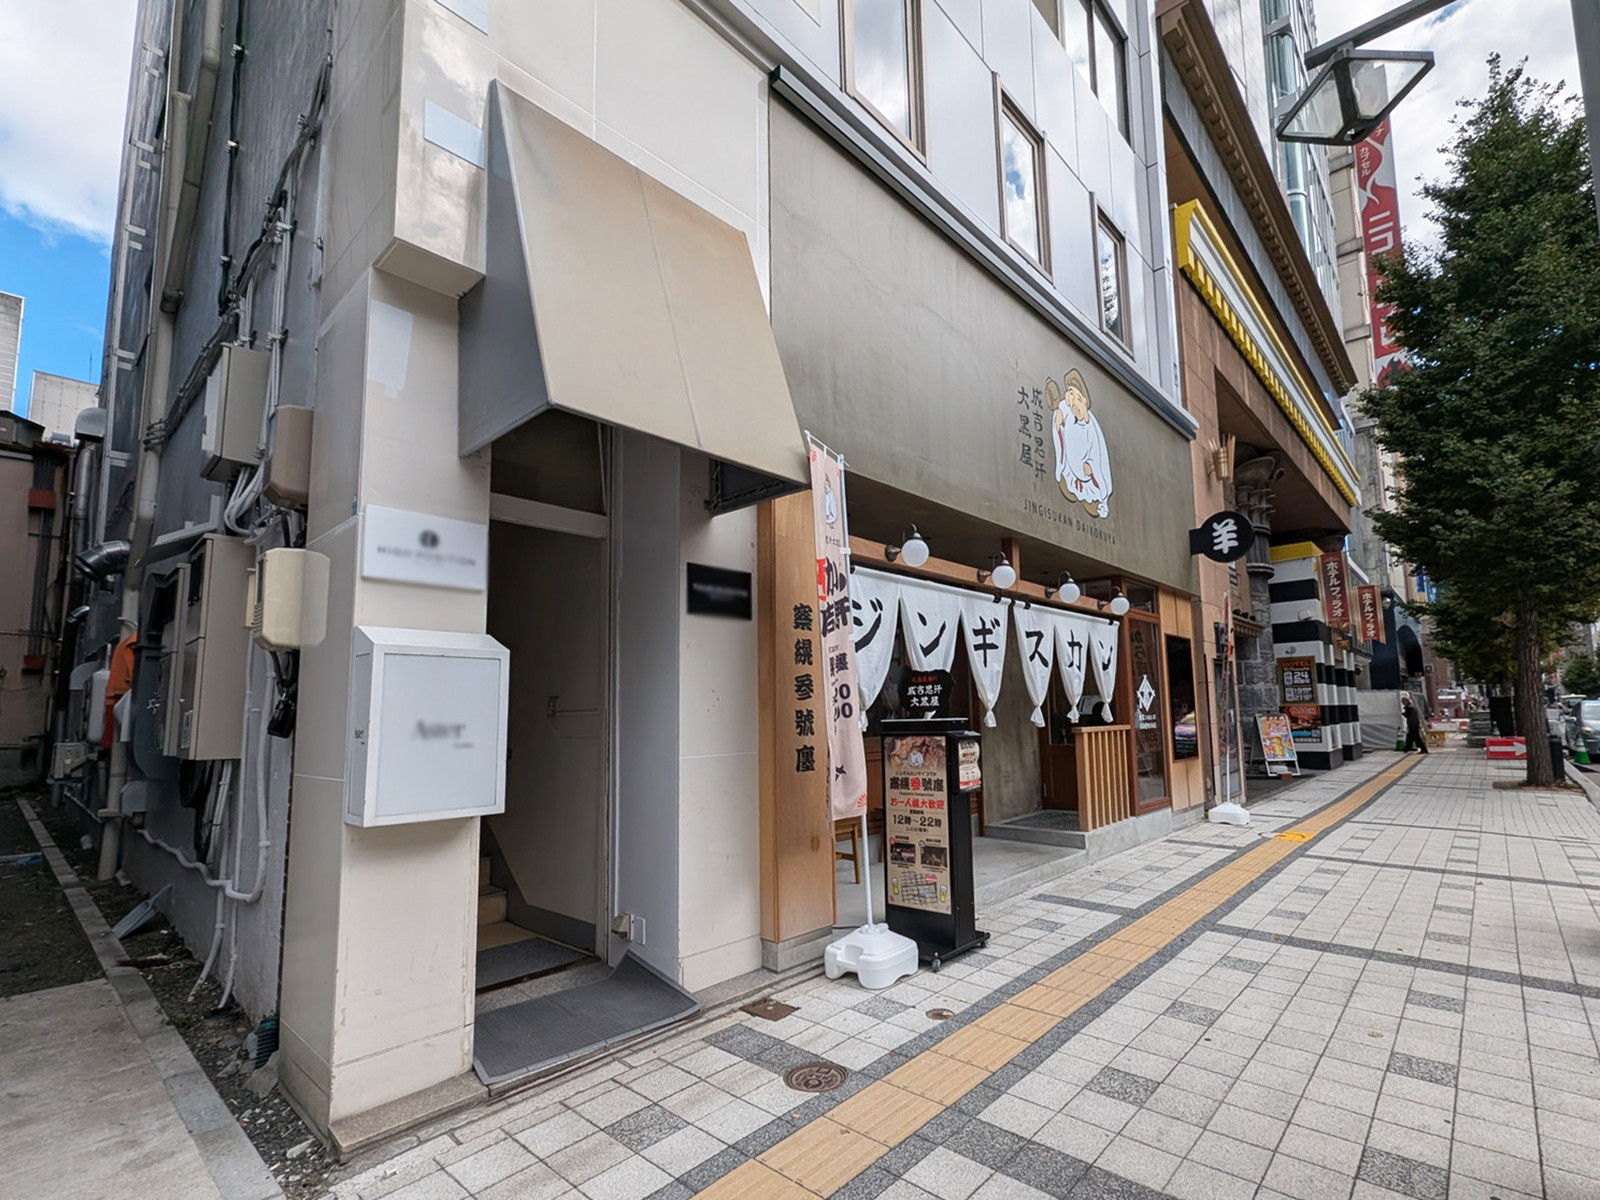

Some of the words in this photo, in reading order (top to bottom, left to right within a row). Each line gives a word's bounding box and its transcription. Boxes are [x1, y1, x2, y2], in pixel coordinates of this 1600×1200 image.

[1017, 386, 1034, 468] 大黒屋
[1031, 387, 1047, 481] 成吉思汗
[1024, 499, 1073, 528] JINGISUKAN
[1075, 520, 1117, 546] DAIKOKUYA
[1212, 518, 1240, 554] 羊
[1326, 561, 1345, 618] ホテルファラオ
[1361, 592, 1376, 638] ホテルファラオ
[851, 596, 1114, 672] ジンギスカン
